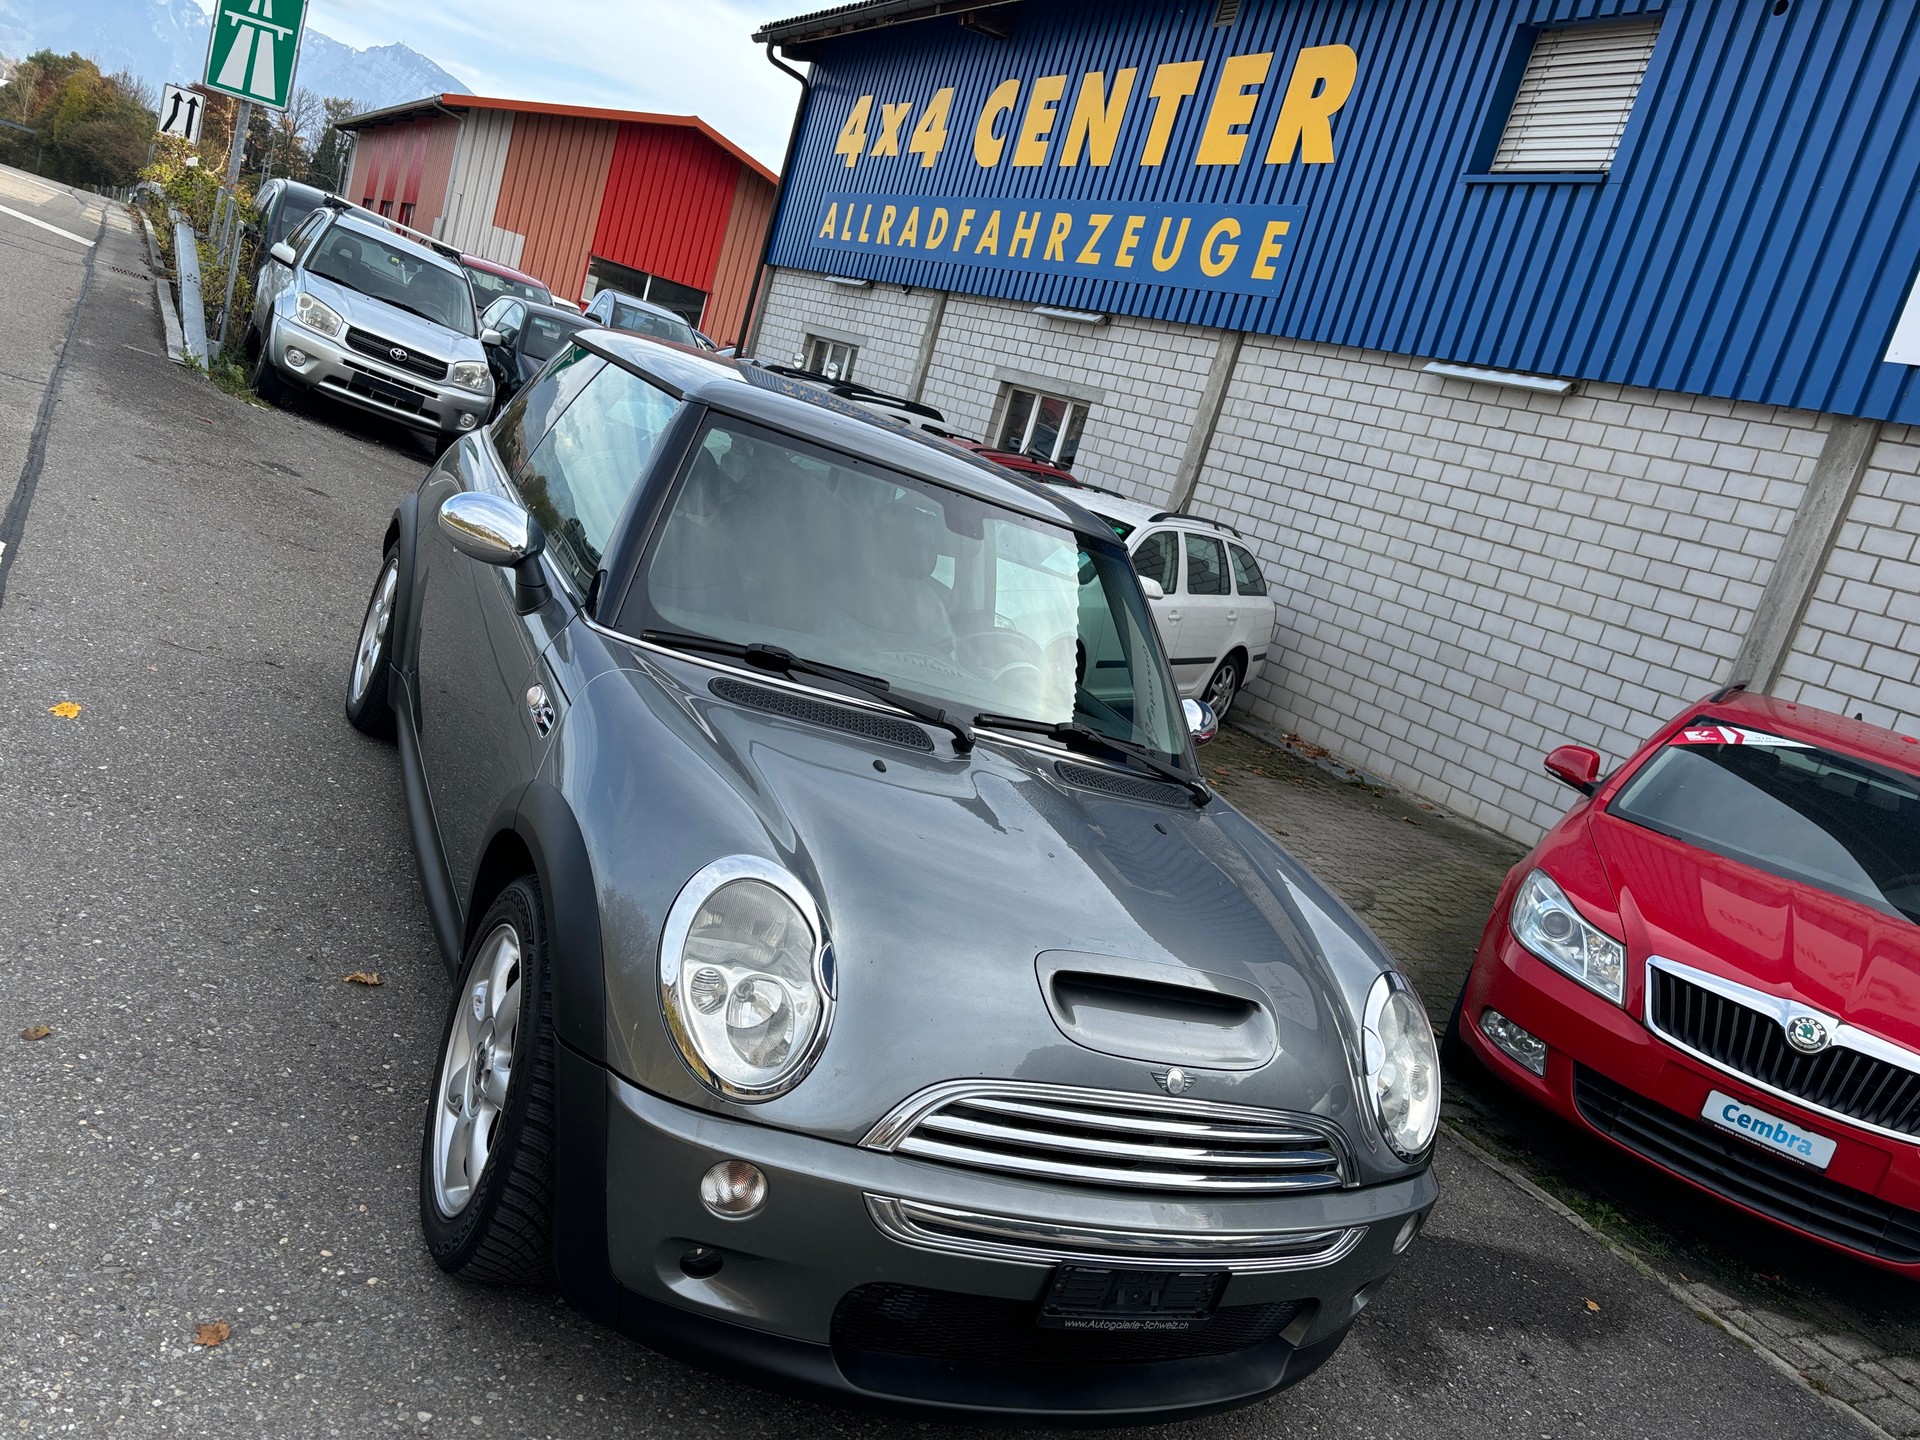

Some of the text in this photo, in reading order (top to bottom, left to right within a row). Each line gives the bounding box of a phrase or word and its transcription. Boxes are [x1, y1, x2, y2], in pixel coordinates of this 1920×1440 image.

[834, 43, 1358, 168] 4x4 CENTER
[819, 201, 1290, 281] ALLRADFAHRZEUGE
[1722, 1104, 1812, 1156] Cembra
[1064, 1319, 1189, 1331] www.Autogalerie-Schweiz.ch
